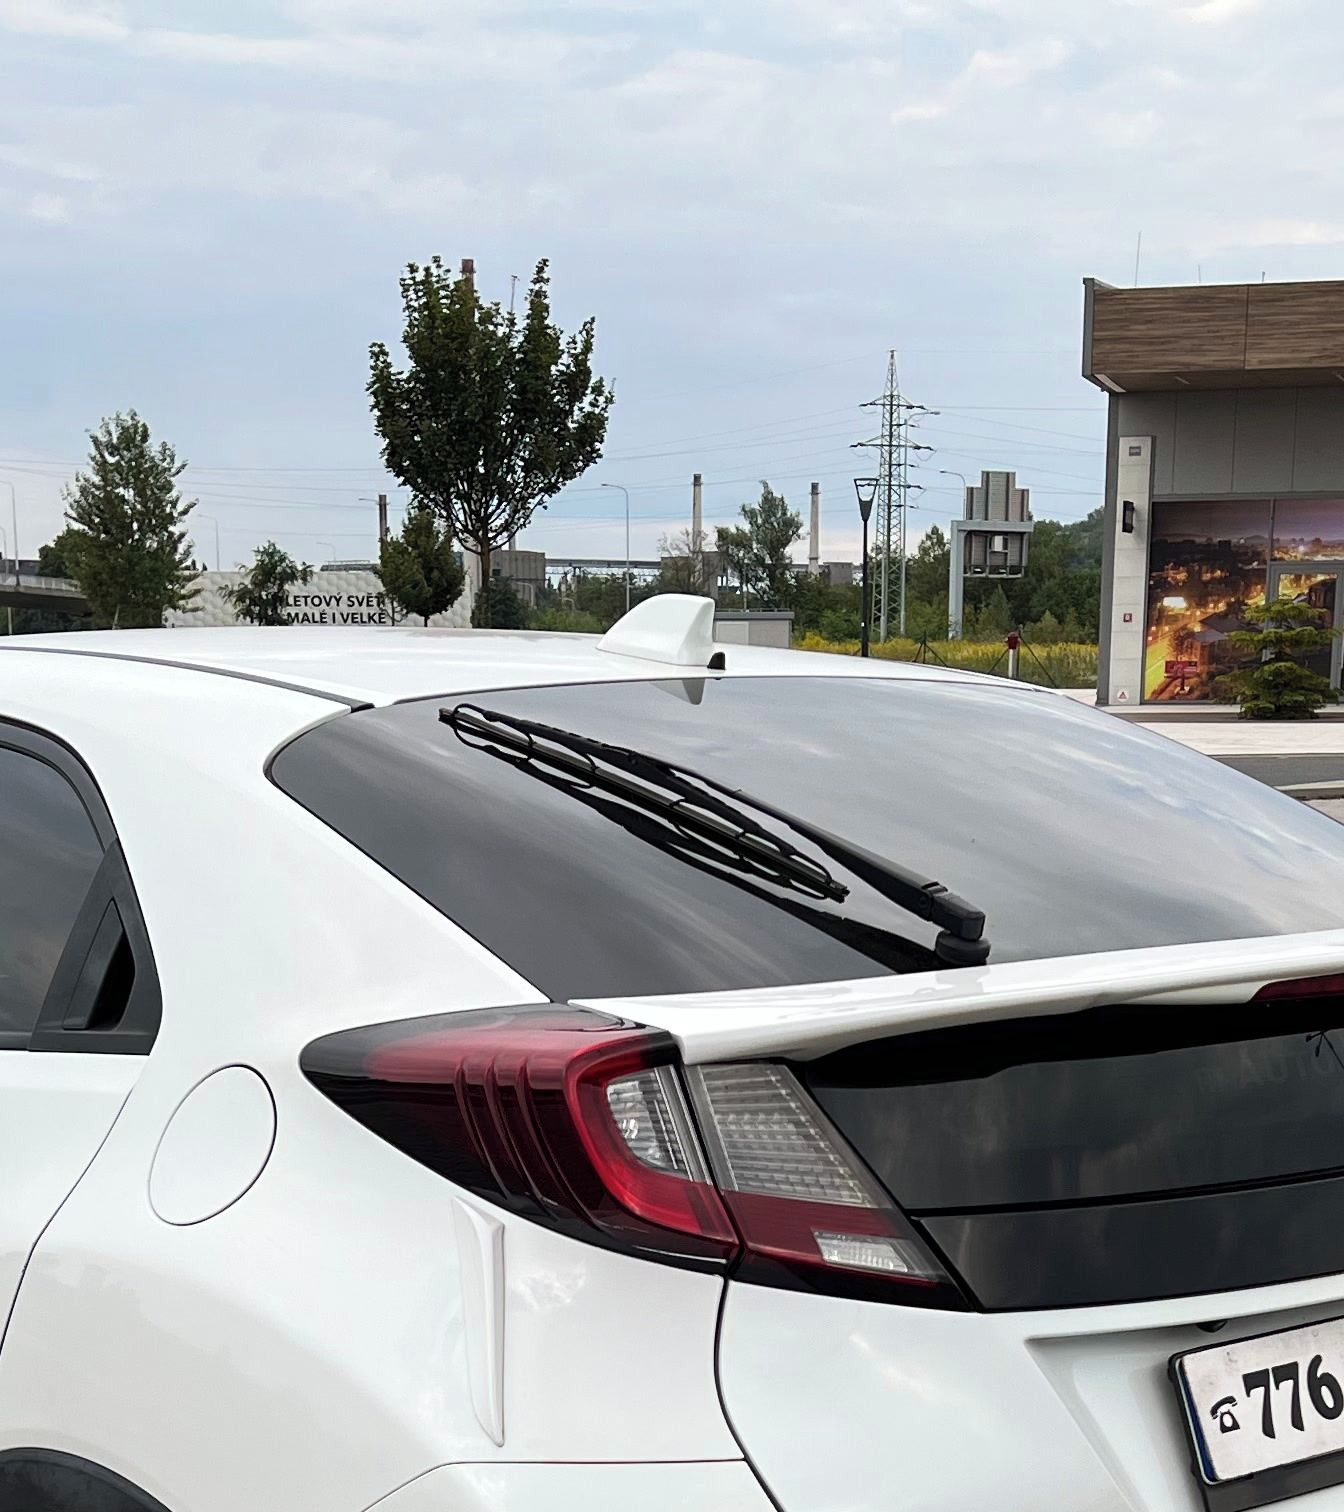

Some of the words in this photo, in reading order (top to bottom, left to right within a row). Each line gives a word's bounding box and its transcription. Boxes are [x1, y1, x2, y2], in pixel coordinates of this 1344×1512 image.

[286, 592, 343, 608] LETOVÝ
[286, 609, 328, 624] MALÉ
[332, 612, 337, 624] I
[1242, 1354, 1344, 1440] 776
